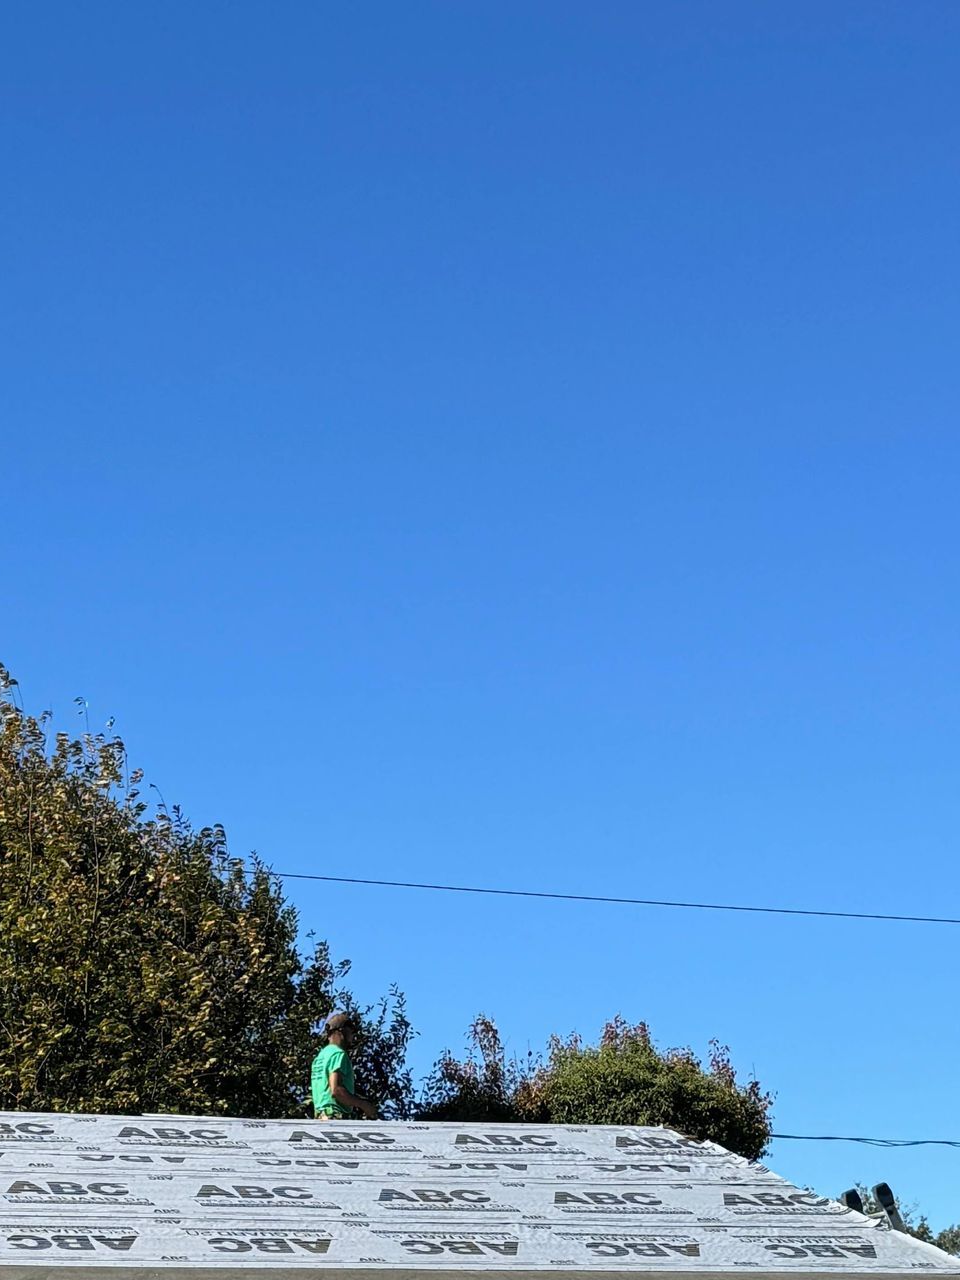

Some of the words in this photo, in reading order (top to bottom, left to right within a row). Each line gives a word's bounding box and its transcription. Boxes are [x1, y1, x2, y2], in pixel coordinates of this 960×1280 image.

[118, 1127, 227, 1140] ABC
[289, 1131, 395, 1143] ABC
[455, 1134, 557, 1146] ABC
[6, 1181, 129, 1196] ABC
[197, 1185, 313, 1199] ABC
[378, 1189, 491, 1203] ABC
[554, 1191, 662, 1206] ABC
[723, 1193, 830, 1207] ABC
[7, 1234, 139, 1250] ABC
[208, 1238, 332, 1253] ABC
[400, 1240, 518, 1256] ABC
[586, 1243, 700, 1257] ABC
[765, 1244, 877, 1259] ABC
